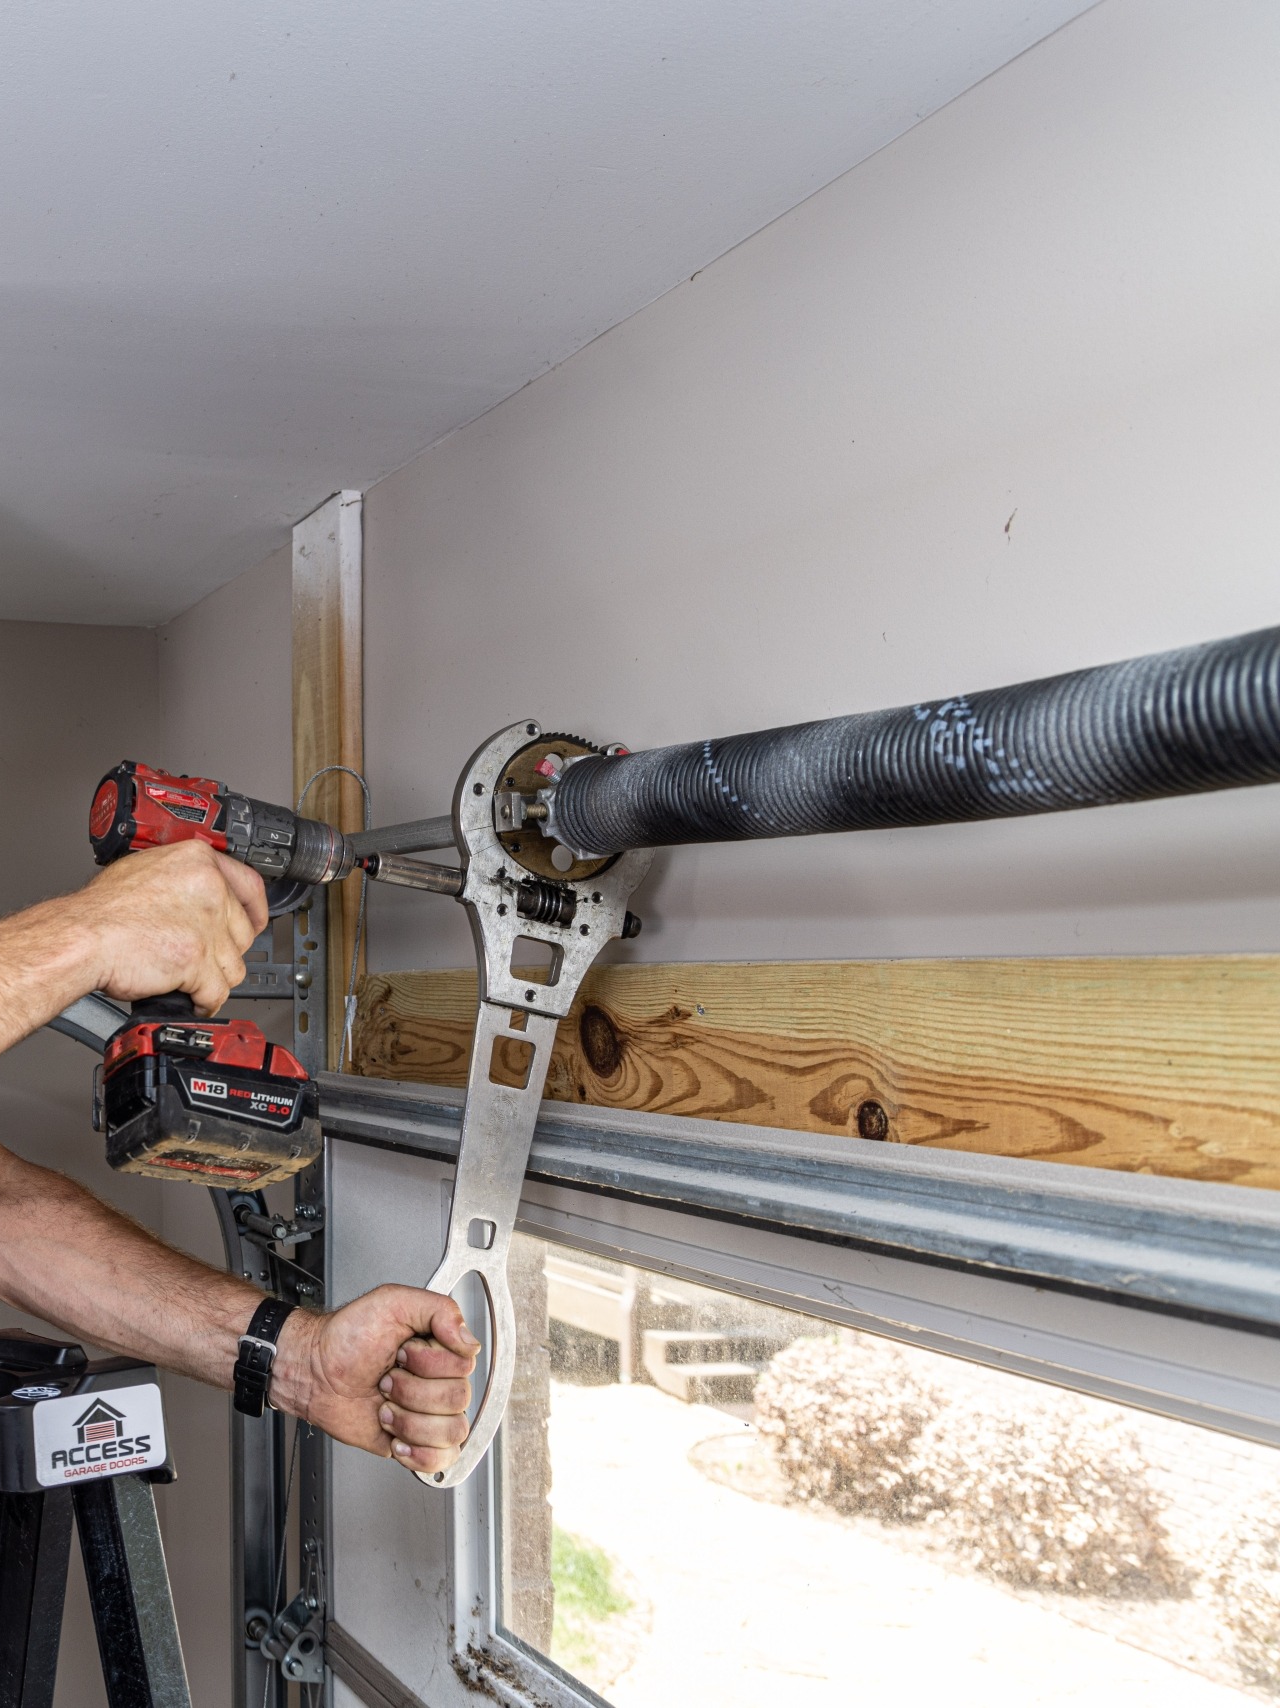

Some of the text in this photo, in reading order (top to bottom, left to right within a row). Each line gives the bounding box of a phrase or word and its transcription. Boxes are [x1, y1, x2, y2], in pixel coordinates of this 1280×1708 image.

[193, 1081, 293, 1106] M18 REDLITHIUM
[250, 1101, 290, 1115] XC5.0
[51, 1434, 151, 1469] ACCESS
[64, 1463, 107, 1478] GARAGE
